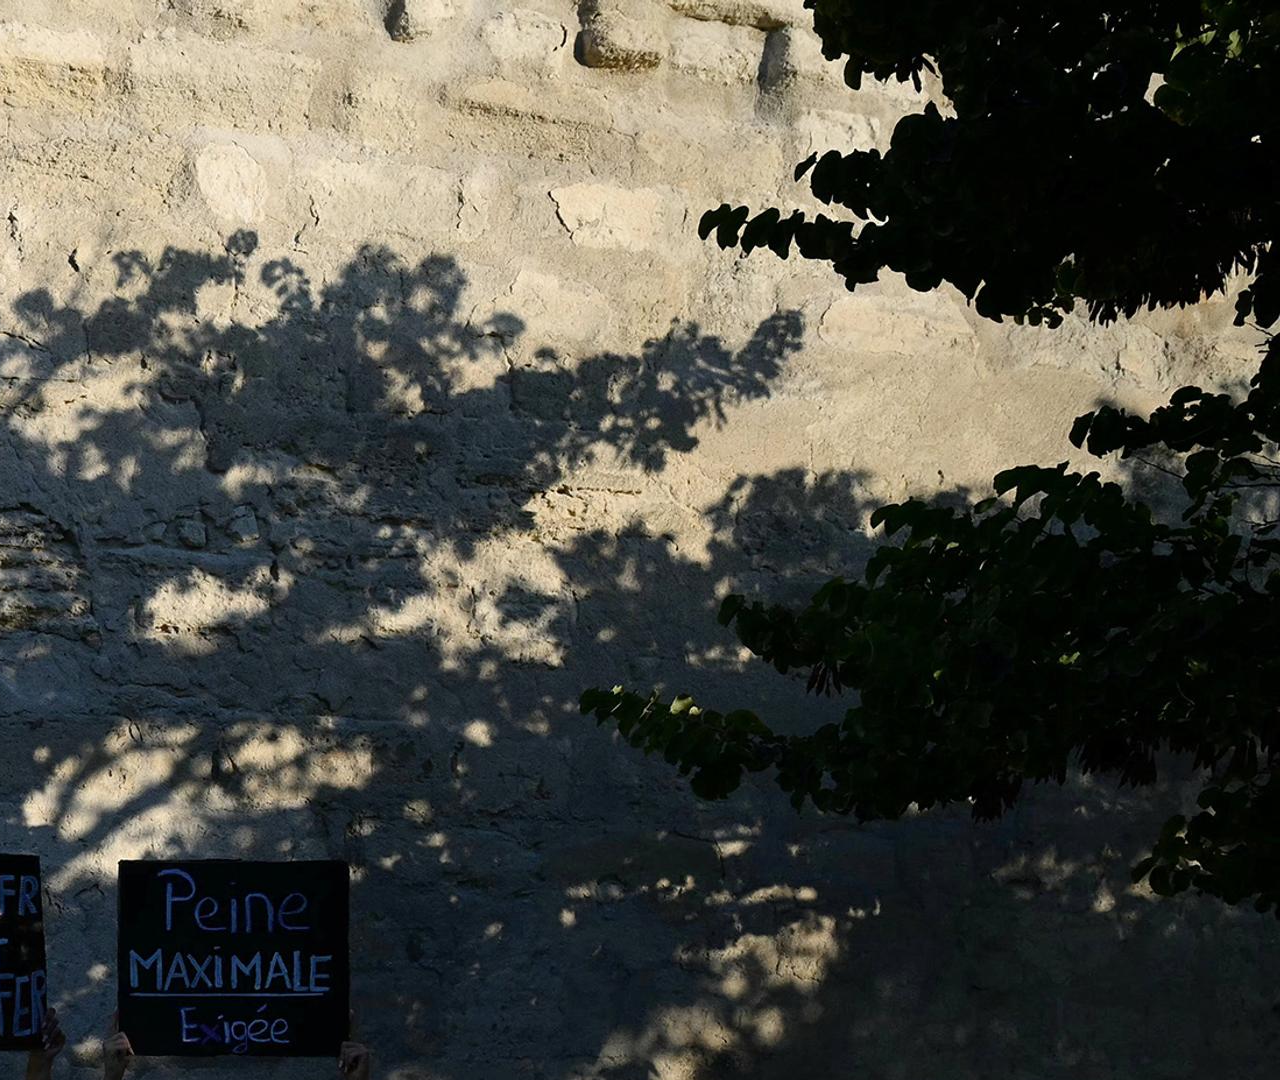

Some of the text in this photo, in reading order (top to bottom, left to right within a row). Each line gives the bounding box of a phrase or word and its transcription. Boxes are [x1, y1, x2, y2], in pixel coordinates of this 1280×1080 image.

[158, 868, 311, 933] Peine
[129, 946, 333, 991] MAXIMALE
[180, 1004, 290, 1056] Exigée
